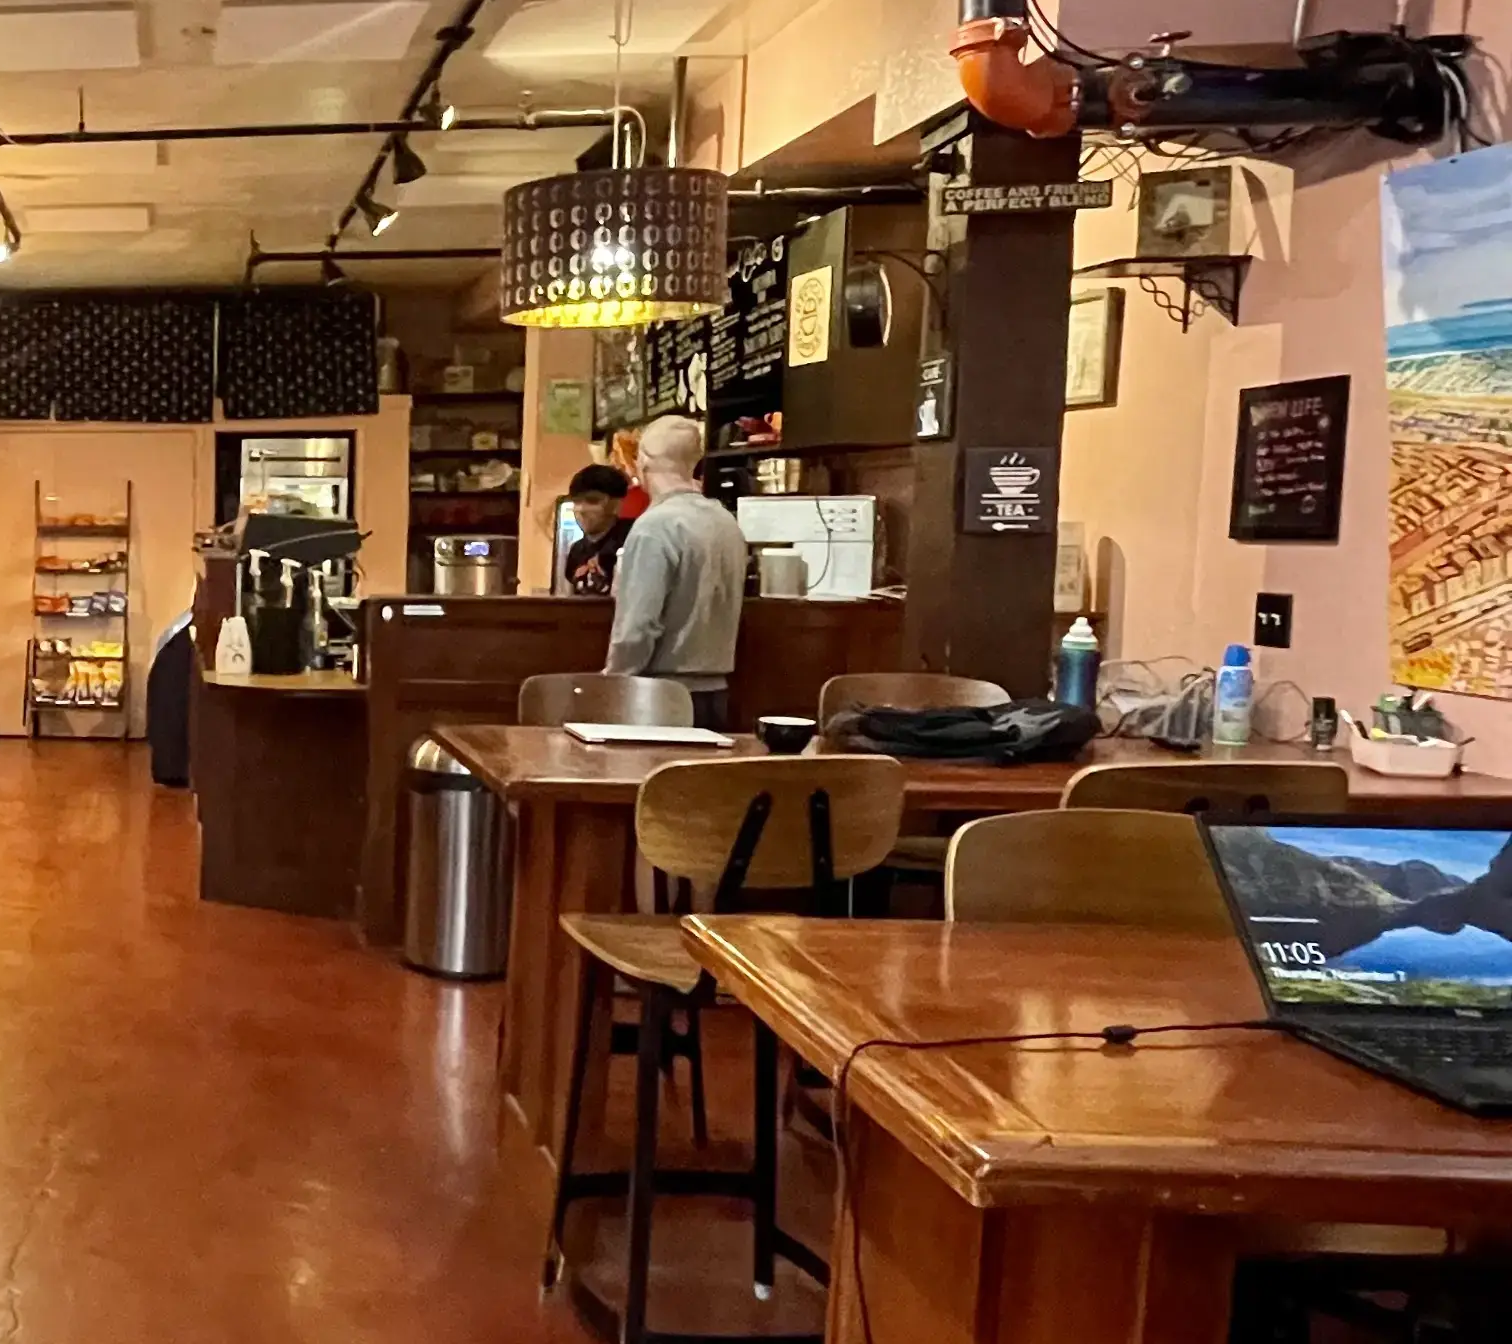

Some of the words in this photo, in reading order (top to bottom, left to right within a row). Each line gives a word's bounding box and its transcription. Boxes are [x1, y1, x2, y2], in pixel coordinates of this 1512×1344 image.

[944, 187, 1004, 201] COFFEE
[1008, 186, 1040, 197] AND
[1044, 183, 1109, 196] FRIENDS
[944, 200, 958, 212] A
[963, 196, 1044, 211] PERFECT
[1049, 193, 1109, 207] BLEND
[995, 504, 1026, 517] TEA
[1261, 941, 1326, 965] 11:05
